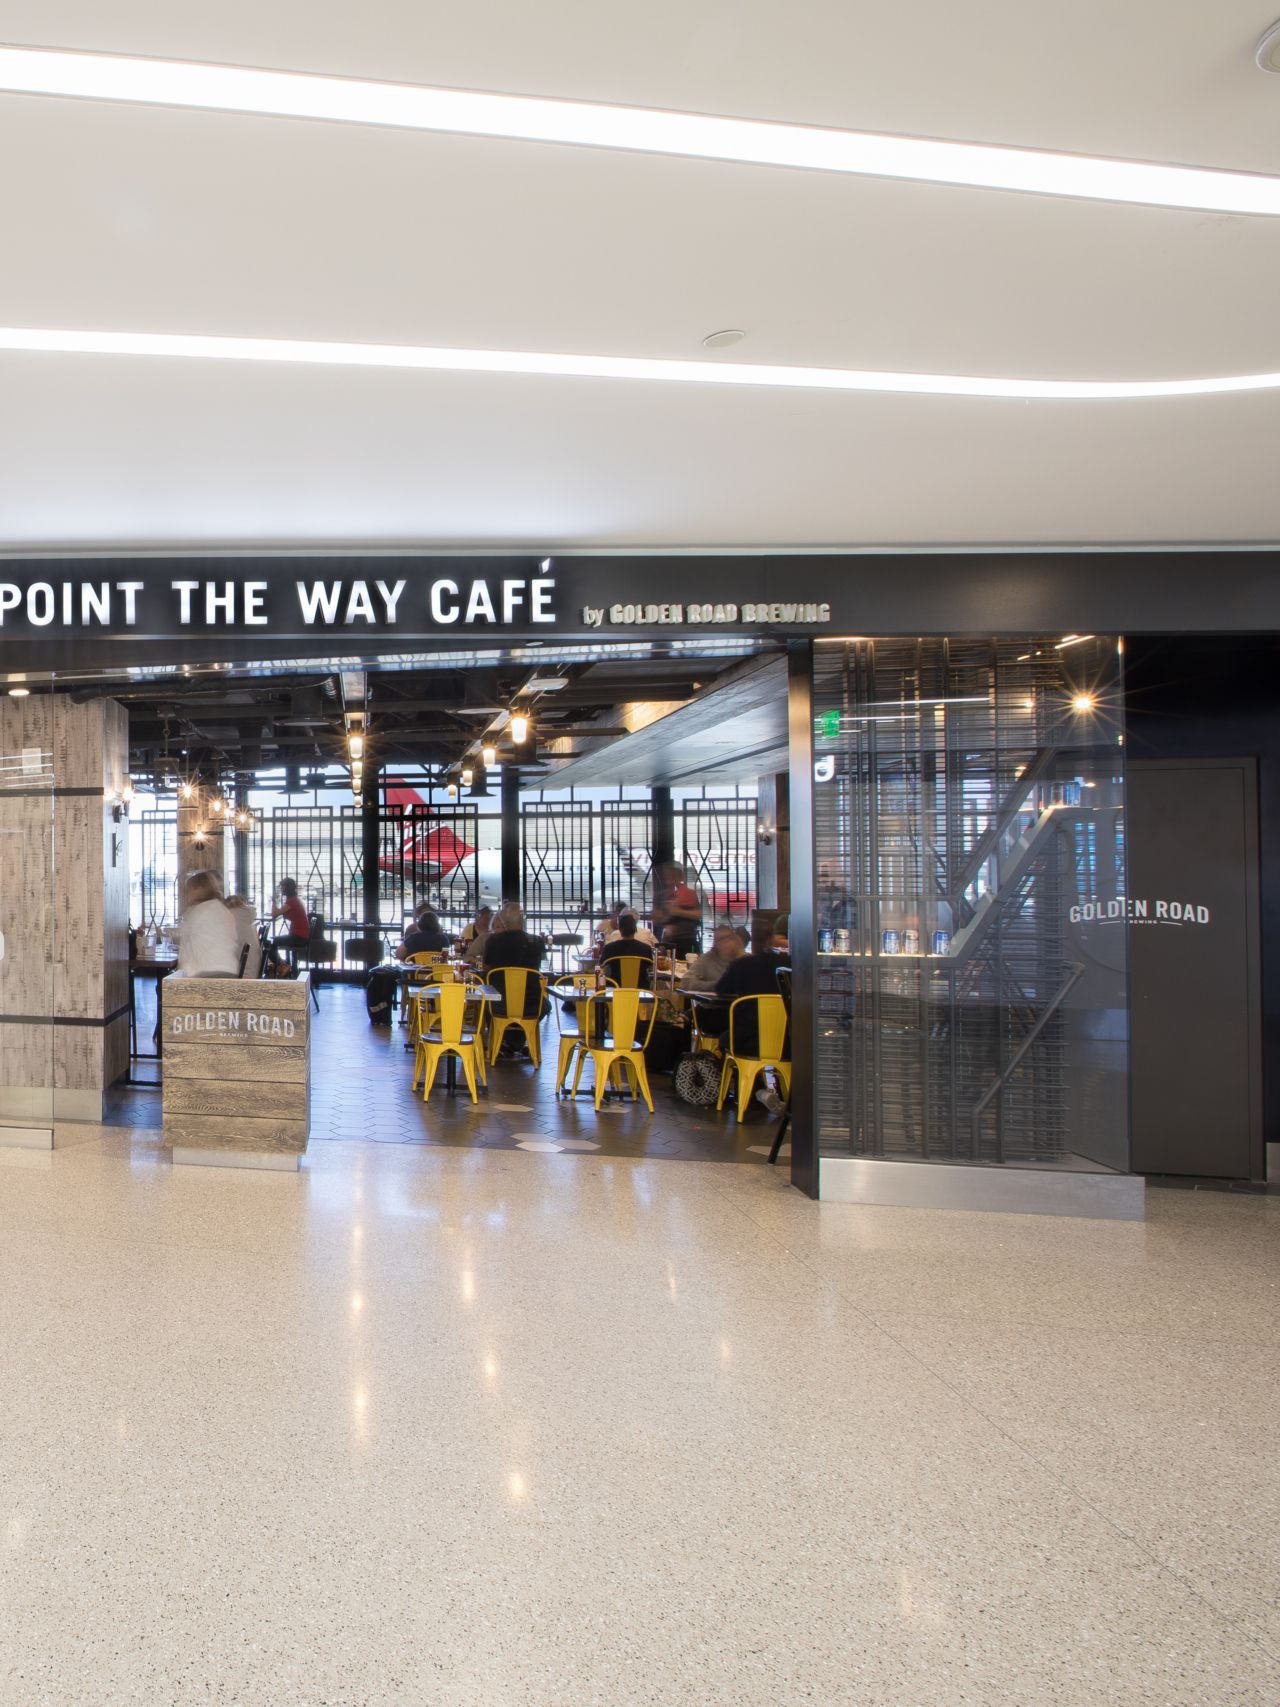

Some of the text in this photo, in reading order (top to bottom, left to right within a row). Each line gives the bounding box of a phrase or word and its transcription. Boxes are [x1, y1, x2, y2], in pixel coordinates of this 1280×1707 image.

[171, 580, 268, 625] THE
[295, 579, 407, 624] WAY
[430, 557, 556, 624] CAFÉ
[583, 603, 831, 628] by GOLDEN ROAD BREWING
[1069, 899, 1210, 924] GOLDEN ROAD
[173, 1011, 296, 1038] GOLDEN ROAD
